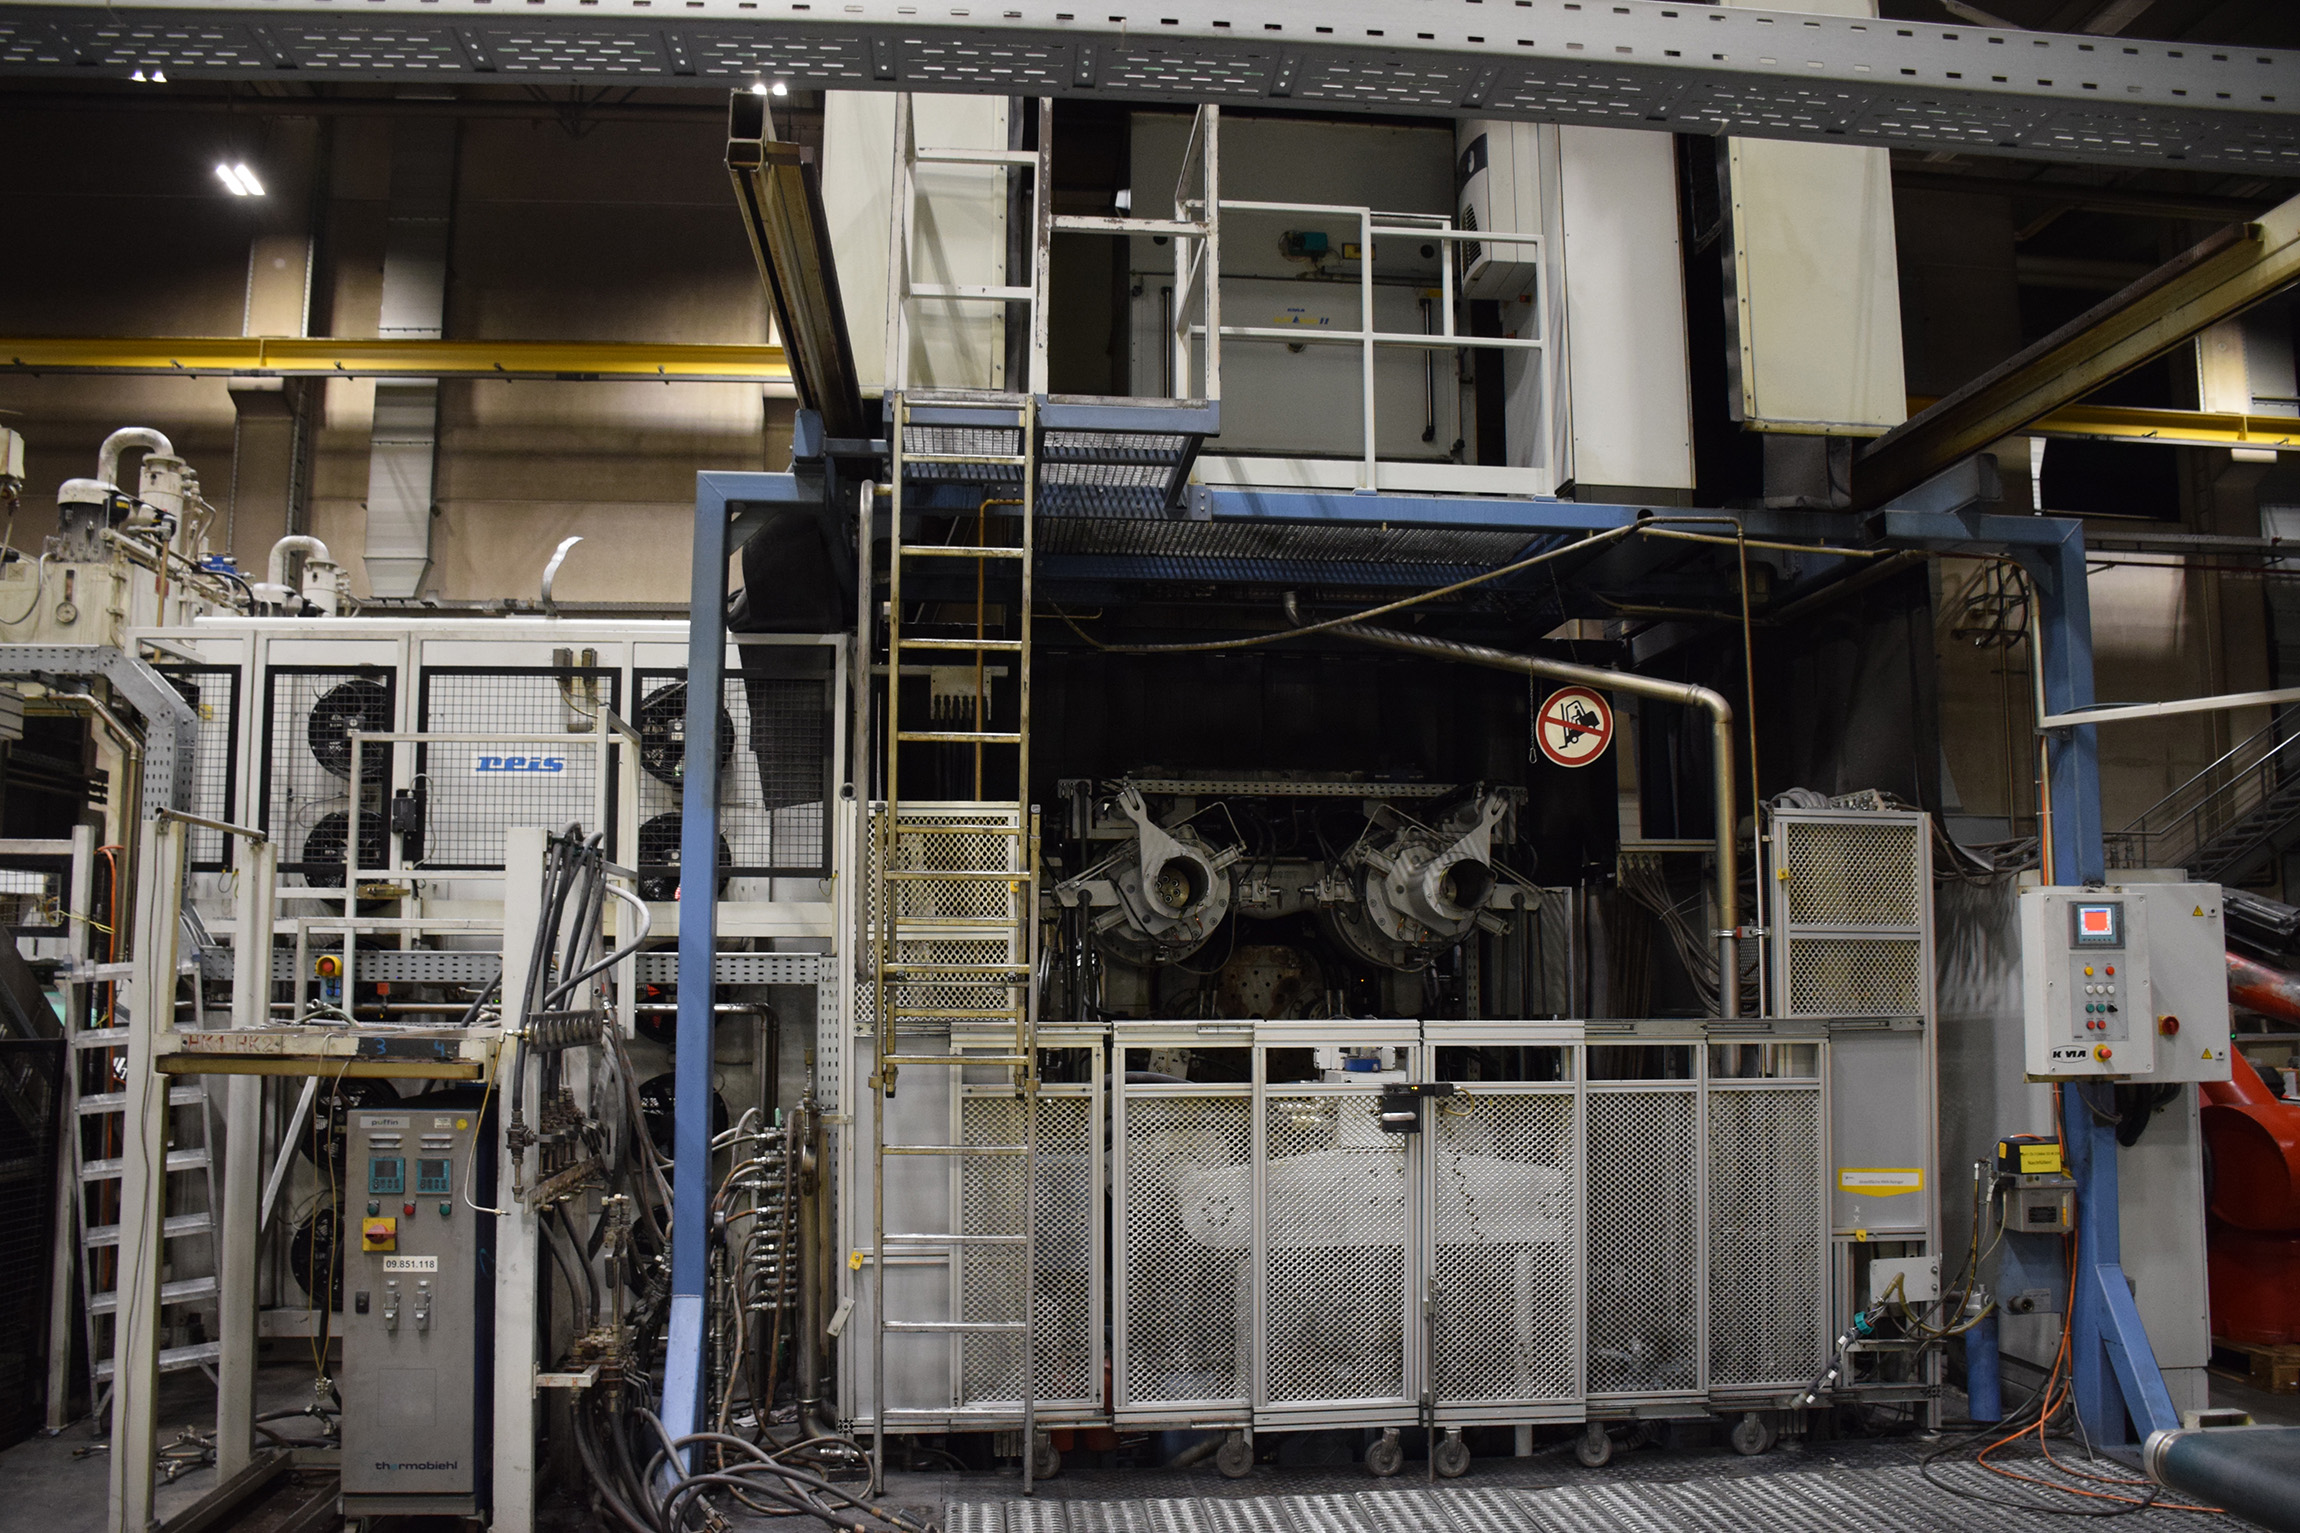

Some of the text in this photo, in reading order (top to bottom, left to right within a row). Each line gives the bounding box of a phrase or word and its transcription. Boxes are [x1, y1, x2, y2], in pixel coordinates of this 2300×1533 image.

[375, 1038, 445, 1056] 3 4
[371, 1119, 399, 1127] puffin
[386, 1260, 435, 1269] 09.851.118
